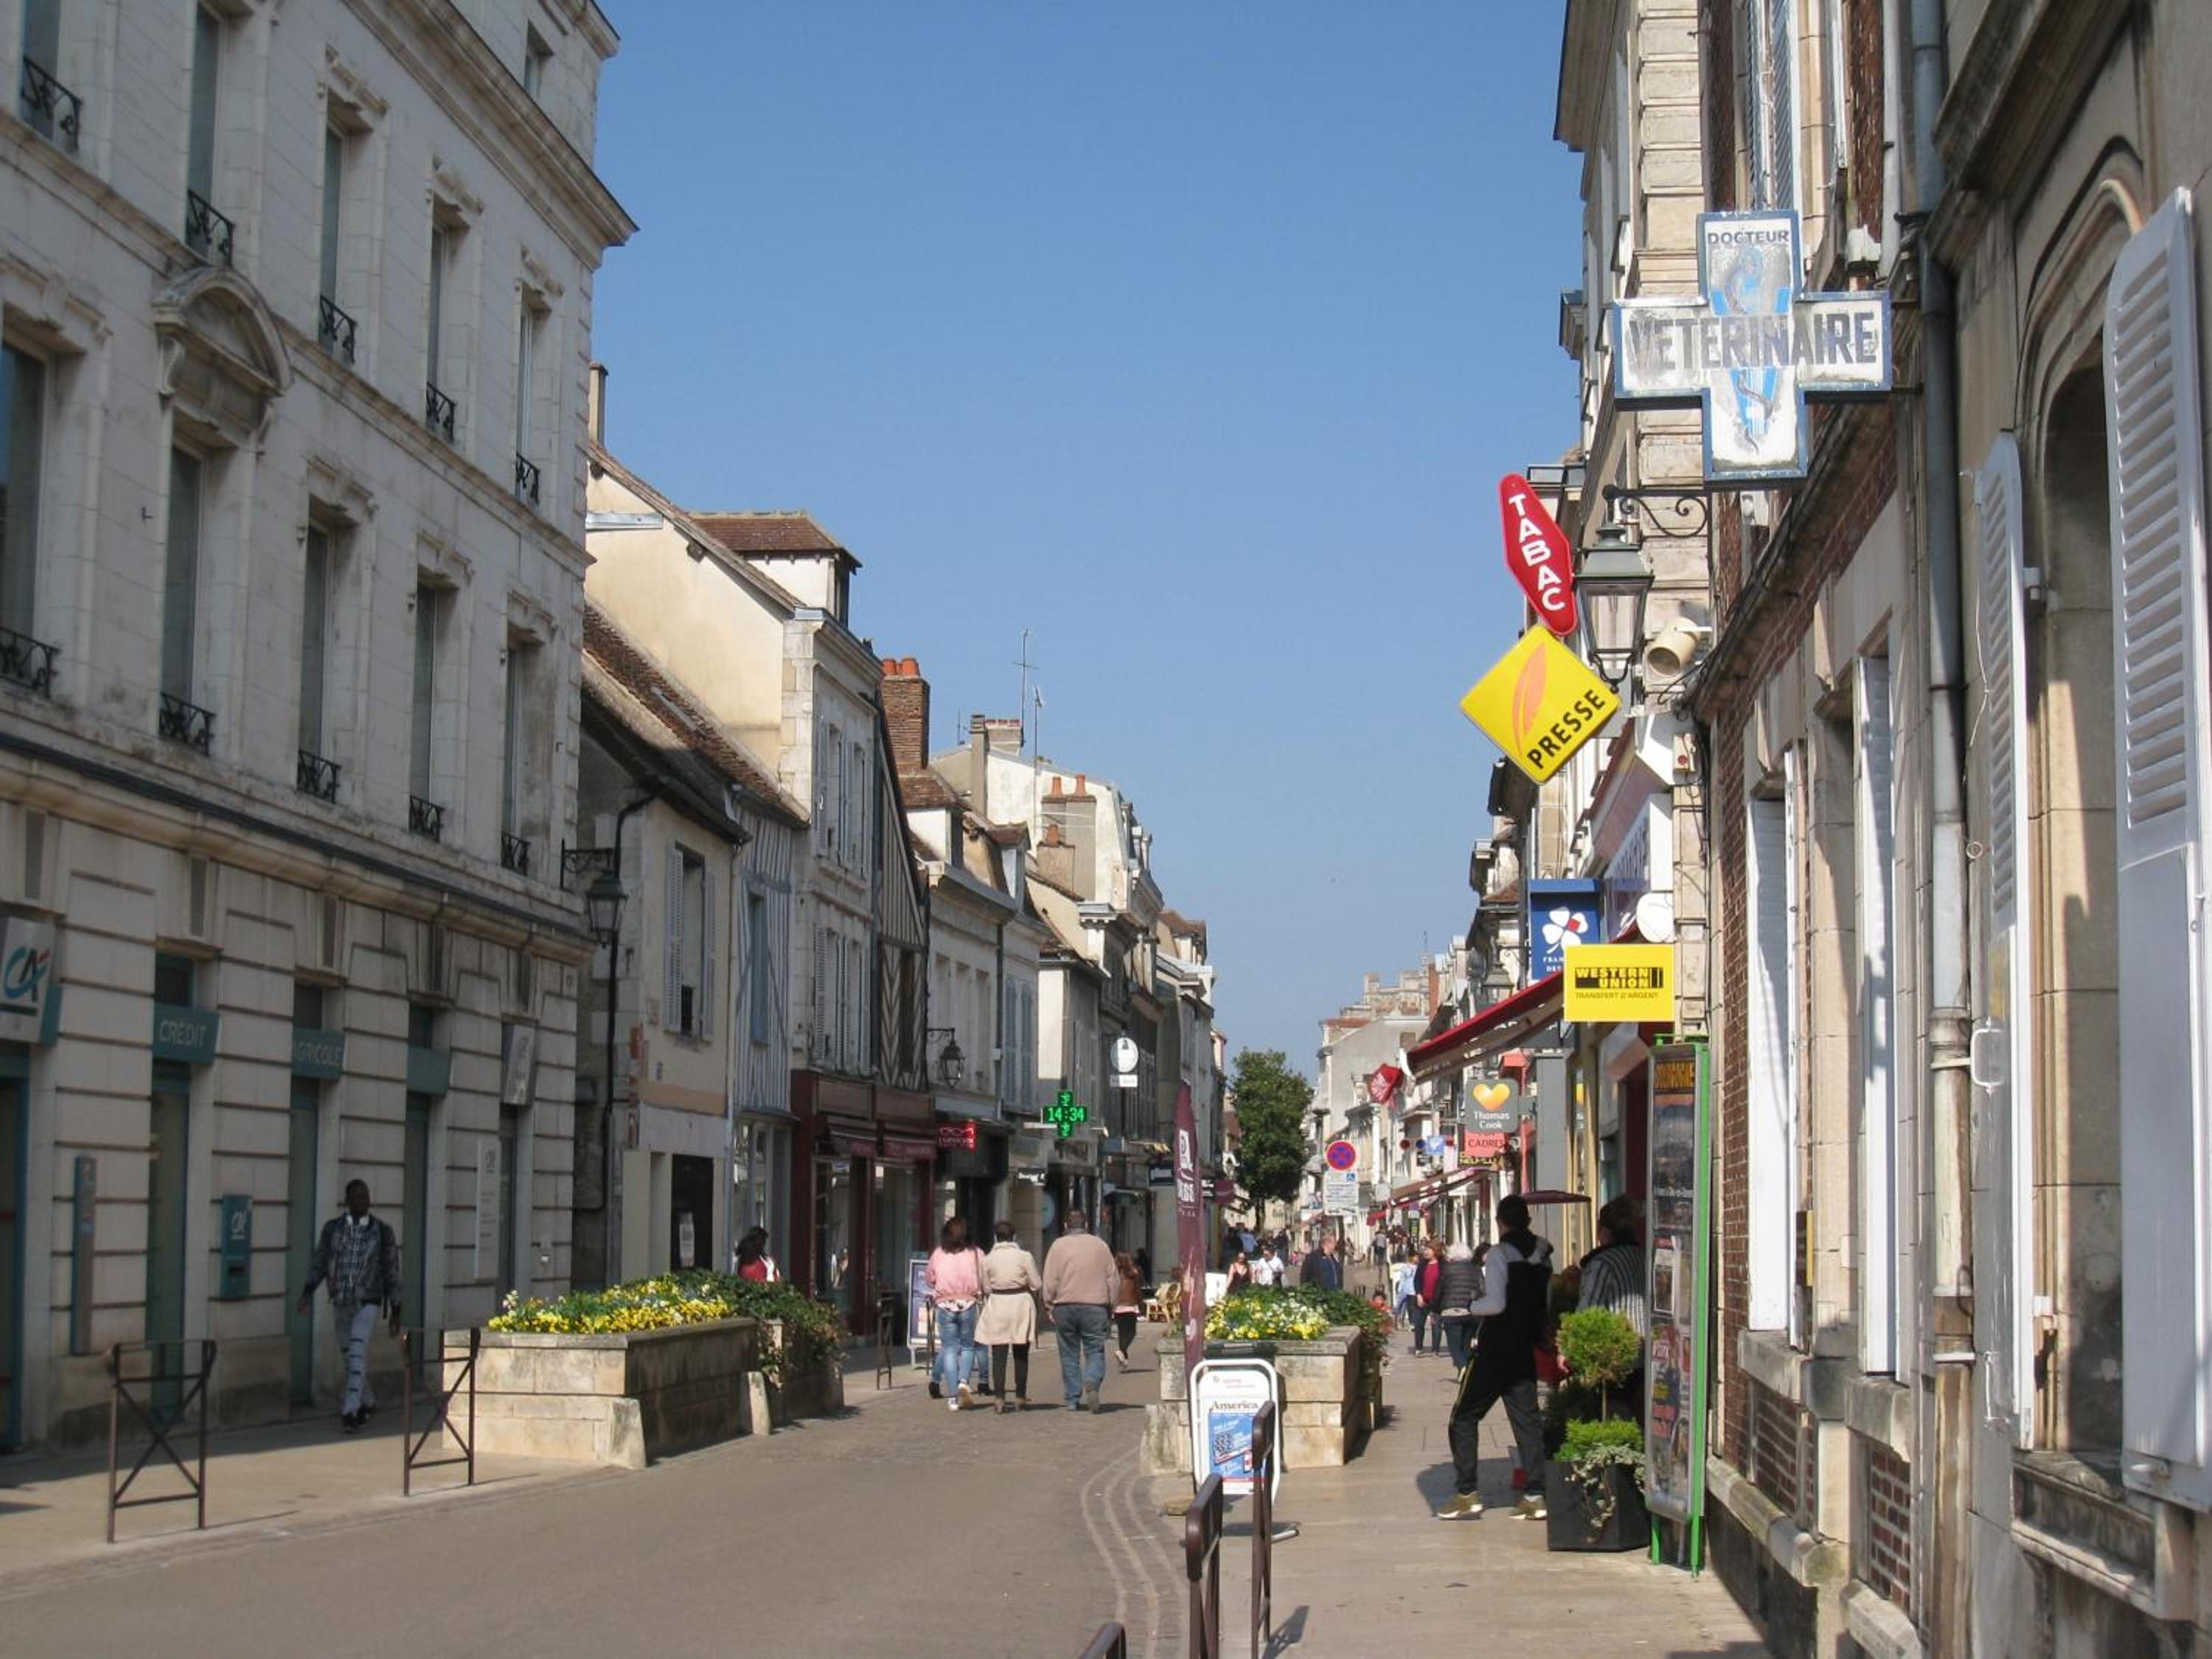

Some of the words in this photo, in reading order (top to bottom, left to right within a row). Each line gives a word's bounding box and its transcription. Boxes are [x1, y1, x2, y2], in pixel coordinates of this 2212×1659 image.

[1707, 230, 1790, 244] DOCTEUR
[1627, 312, 1877, 369] VETERINAIRE
[1508, 493, 1565, 611] TABAC
[1526, 689, 1606, 770] PRESSE
[1576, 968, 1649, 978] WESTERN
[1599, 978, 1649, 988] UNION
[1047, 1107, 1085, 1121] 14:34
[1474, 1111, 1510, 1120] Thomas
[1479, 1120, 1503, 1129] Cook
